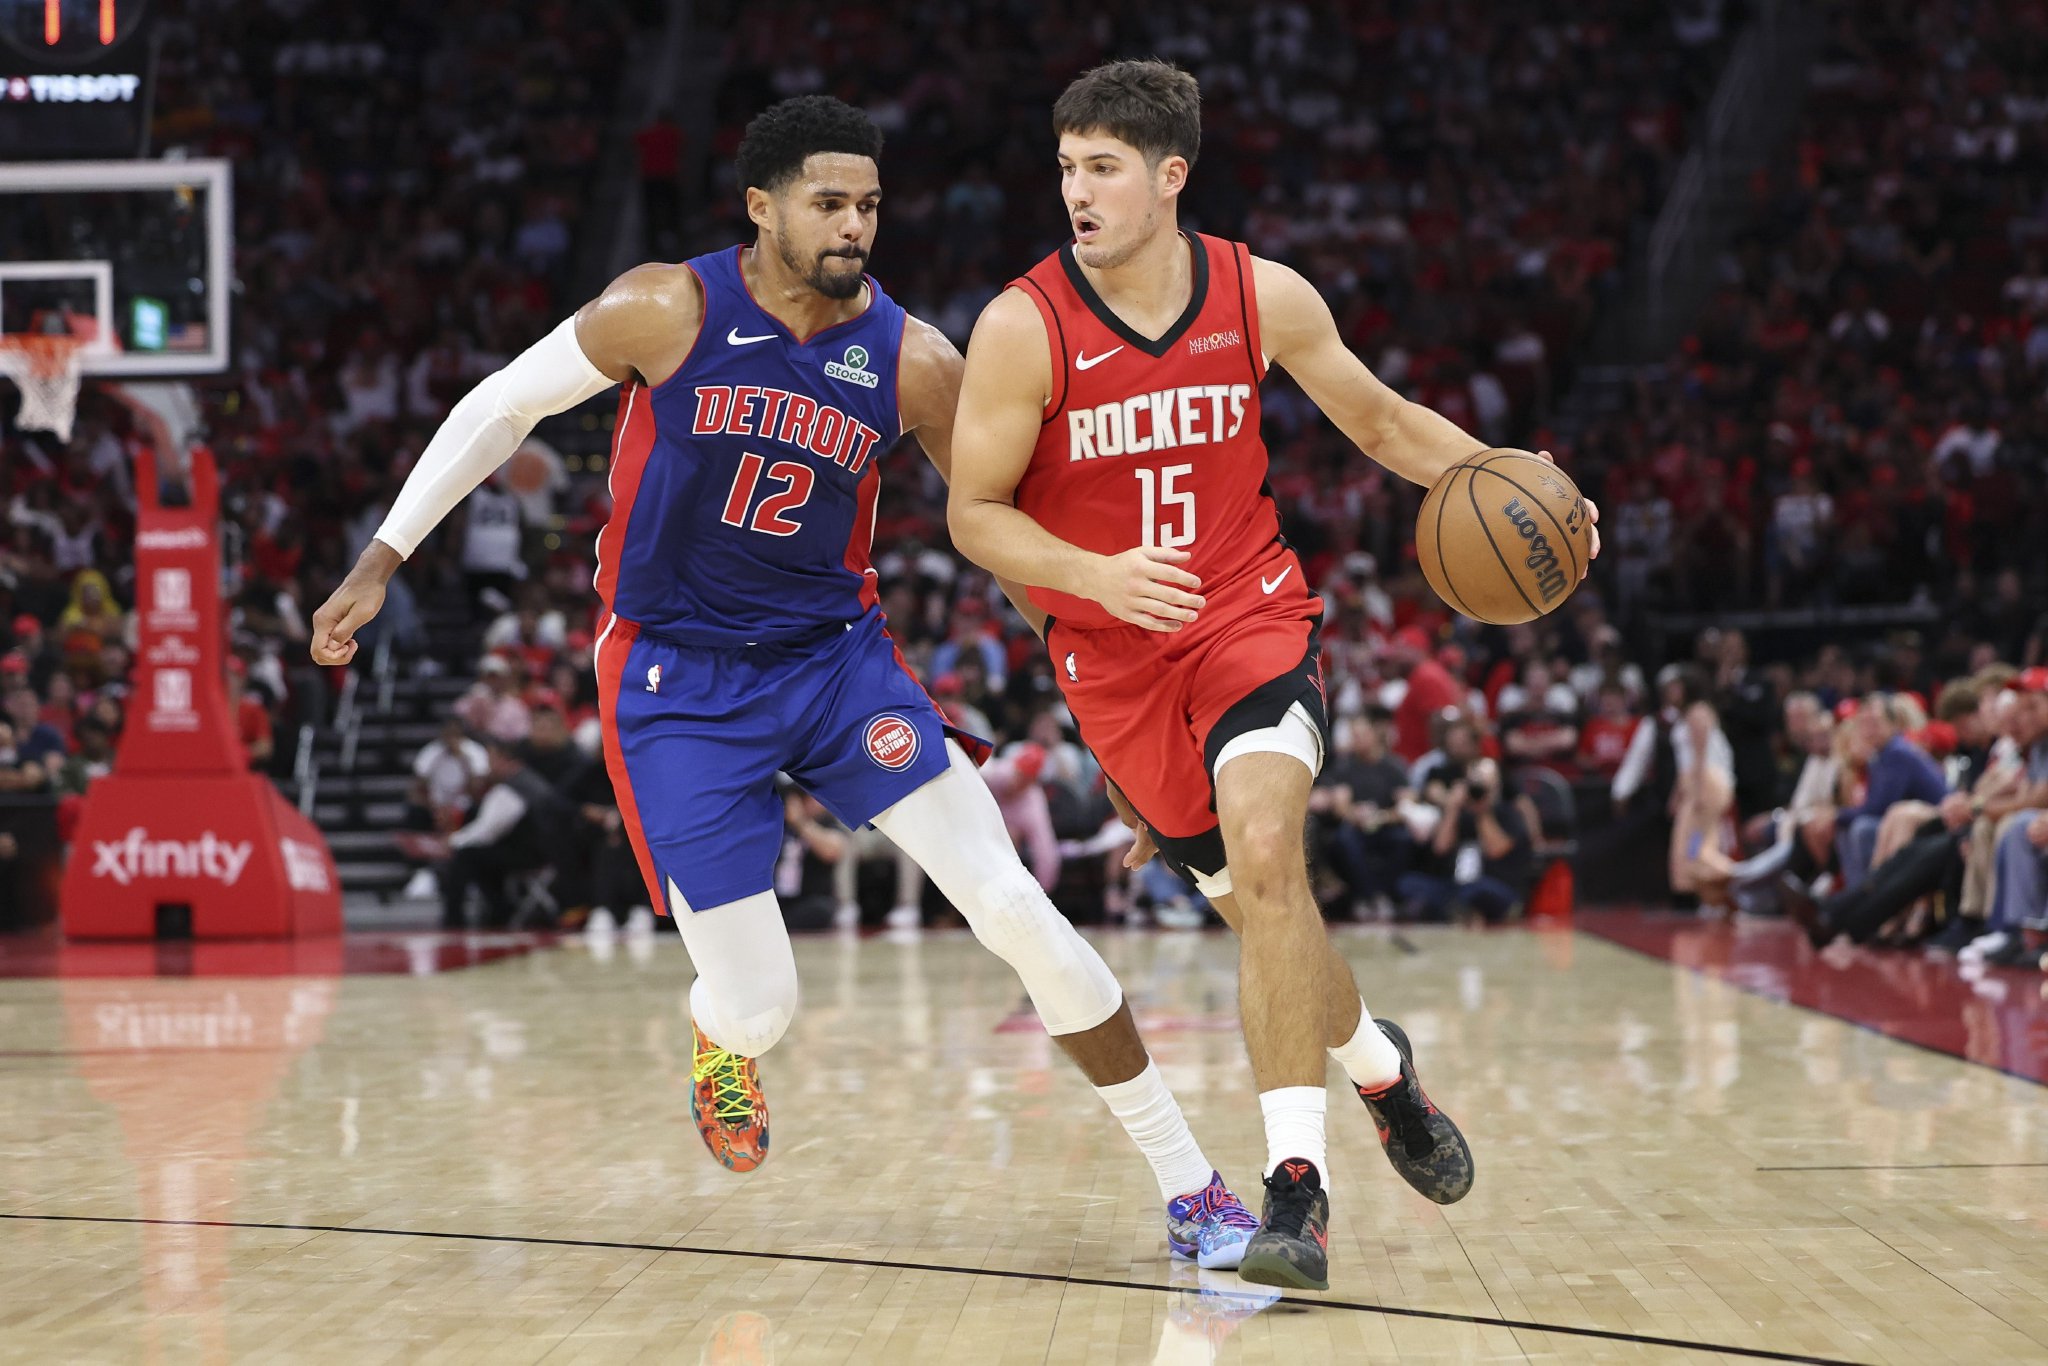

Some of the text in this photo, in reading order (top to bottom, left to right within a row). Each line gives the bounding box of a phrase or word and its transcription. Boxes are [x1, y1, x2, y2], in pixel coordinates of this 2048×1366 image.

[28, 73, 140, 103] TISSOT
[1189, 330, 1240, 348] MEMORIAL
[1190, 337, 1240, 355] HERMANN
[826, 364, 877, 386] StockX
[692, 385, 881, 474] DETROIT
[1067, 384, 1251, 463] ROCKETS
[721, 452, 815, 537] 12
[1134, 463, 1196, 548] 15
[1502, 496, 1568, 605] Wilson
[873, 726, 905, 750] DETROIT
[877, 734, 911, 758] PISTONS
[92, 826, 253, 886] xfinity
